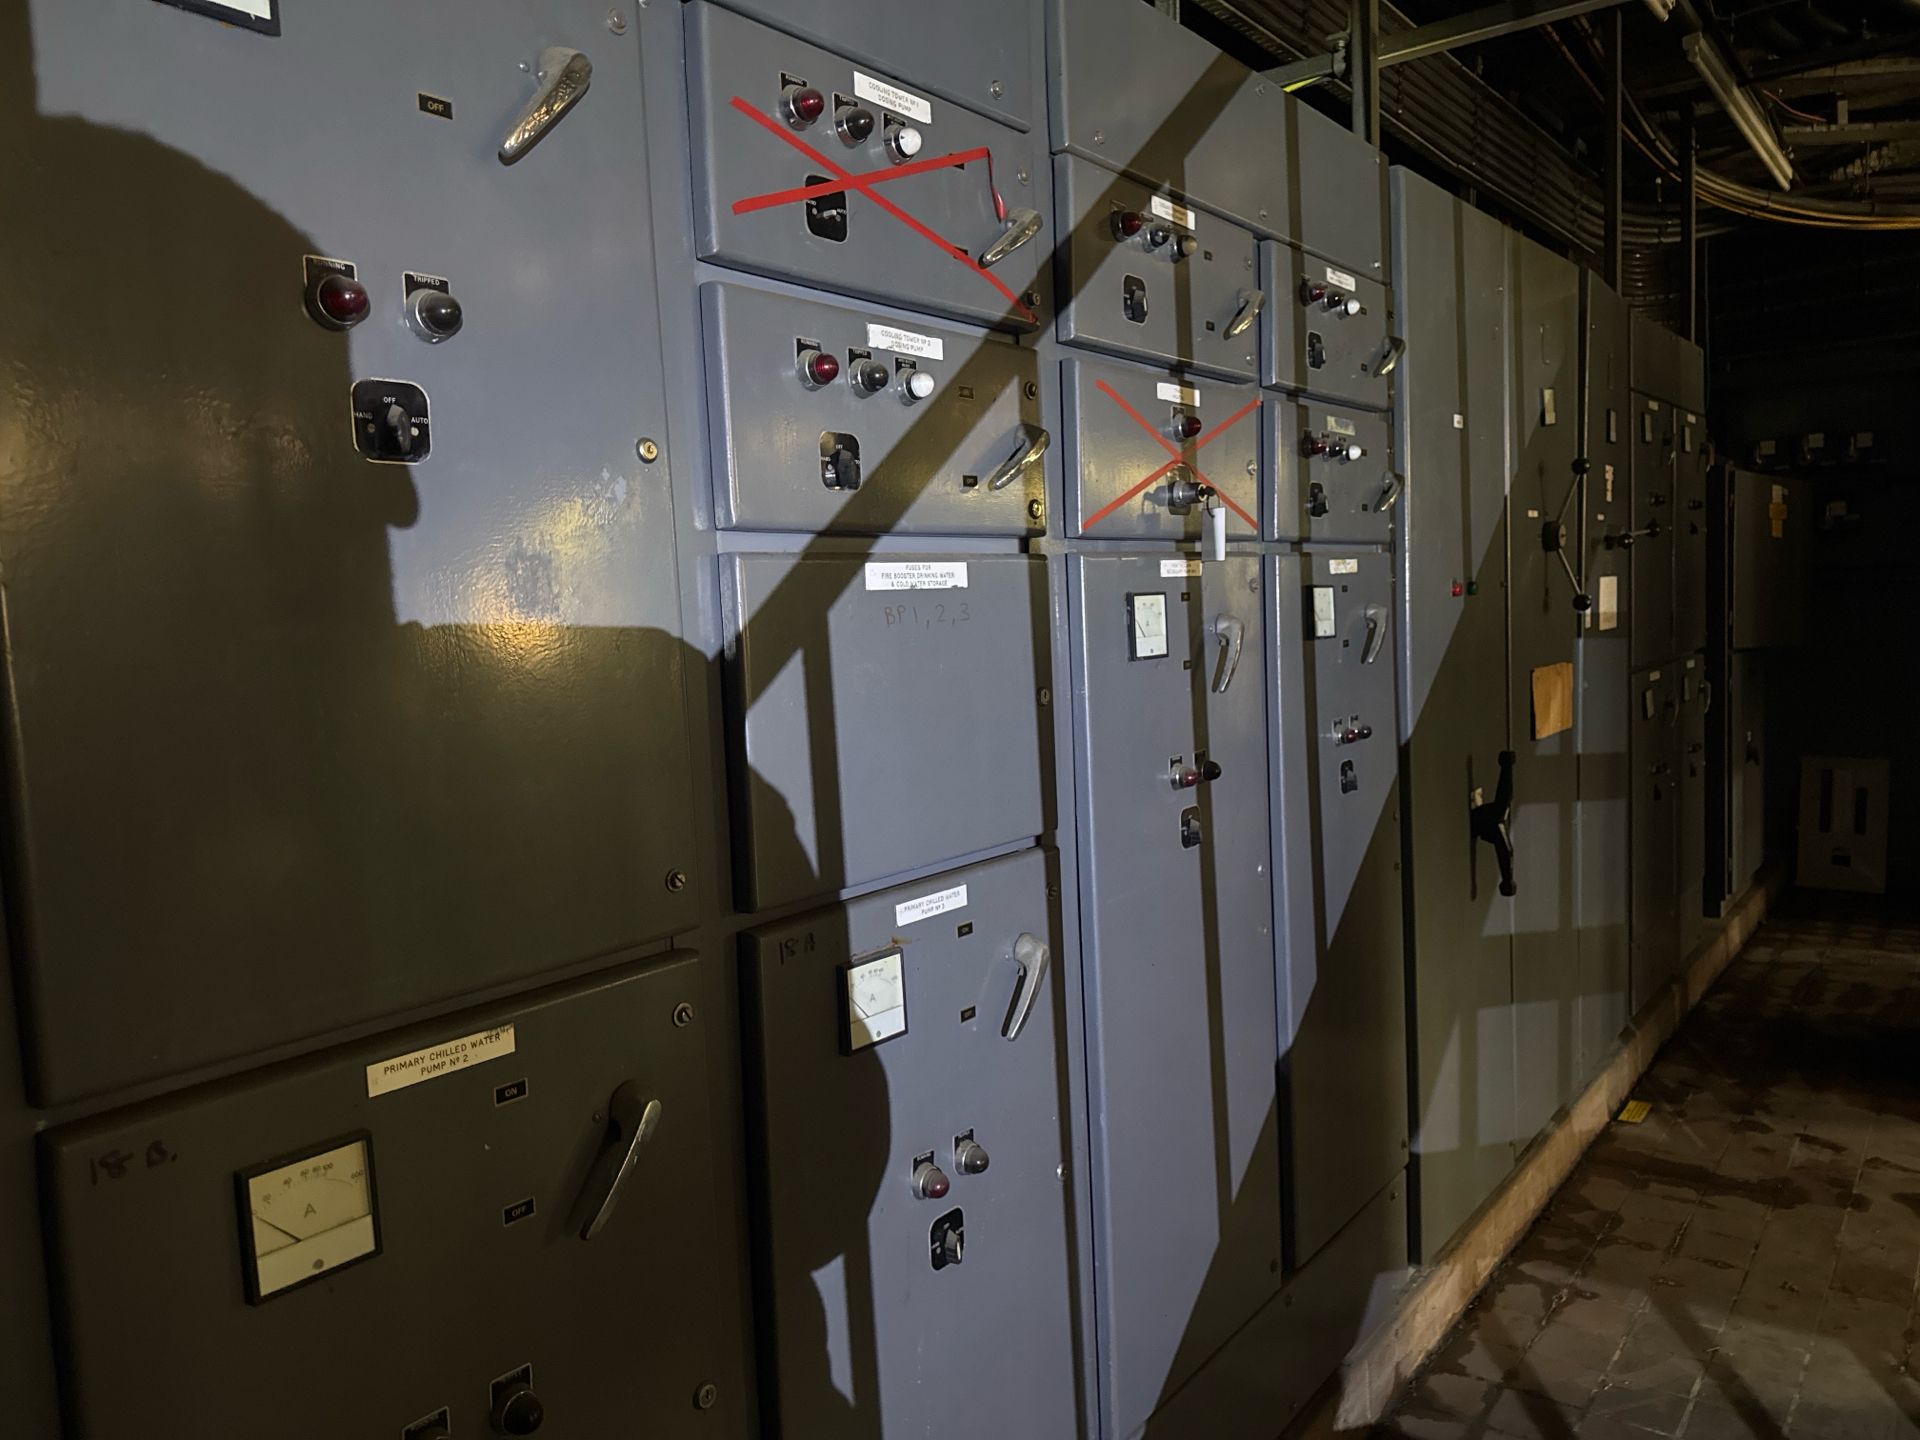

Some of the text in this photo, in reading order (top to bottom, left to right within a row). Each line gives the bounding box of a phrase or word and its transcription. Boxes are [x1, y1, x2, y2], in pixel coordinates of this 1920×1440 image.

[868, 81, 890, 97] COOLING
[891, 90, 909, 103] TOWER
[427, 100, 445, 112] OFF
[878, 93, 912, 113] DOSING PUMP
[413, 275, 440, 287] TRIPPED
[880, 329, 903, 341] COOLING
[903, 334, 920, 344] TOWER
[890, 340, 924, 353] DOSING PUMP
[383, 396, 397, 404] OFF
[353, 411, 374, 420] HAND
[410, 416, 430, 425] AUTO
[881, 572, 892, 580] FIRE
[916, 571, 938, 579] DRINKING
[939, 571, 955, 579] WATER
[896, 580, 909, 588] COLD
[910, 579, 927, 588] WATER
[927, 579, 948, 587] STORAGE
[903, 889, 961, 913] PRIMARY CHILLED WATER
[921, 906, 934, 916] PUMP
[383, 1033, 501, 1076] PRIMARY CHILLED WATER
[420, 1060, 447, 1077] PUMP
[462, 1054, 469, 1064] 2
[504, 1086, 518, 1098] ON
[304, 1202, 317, 1219] A
[511, 1205, 526, 1218] OFF
